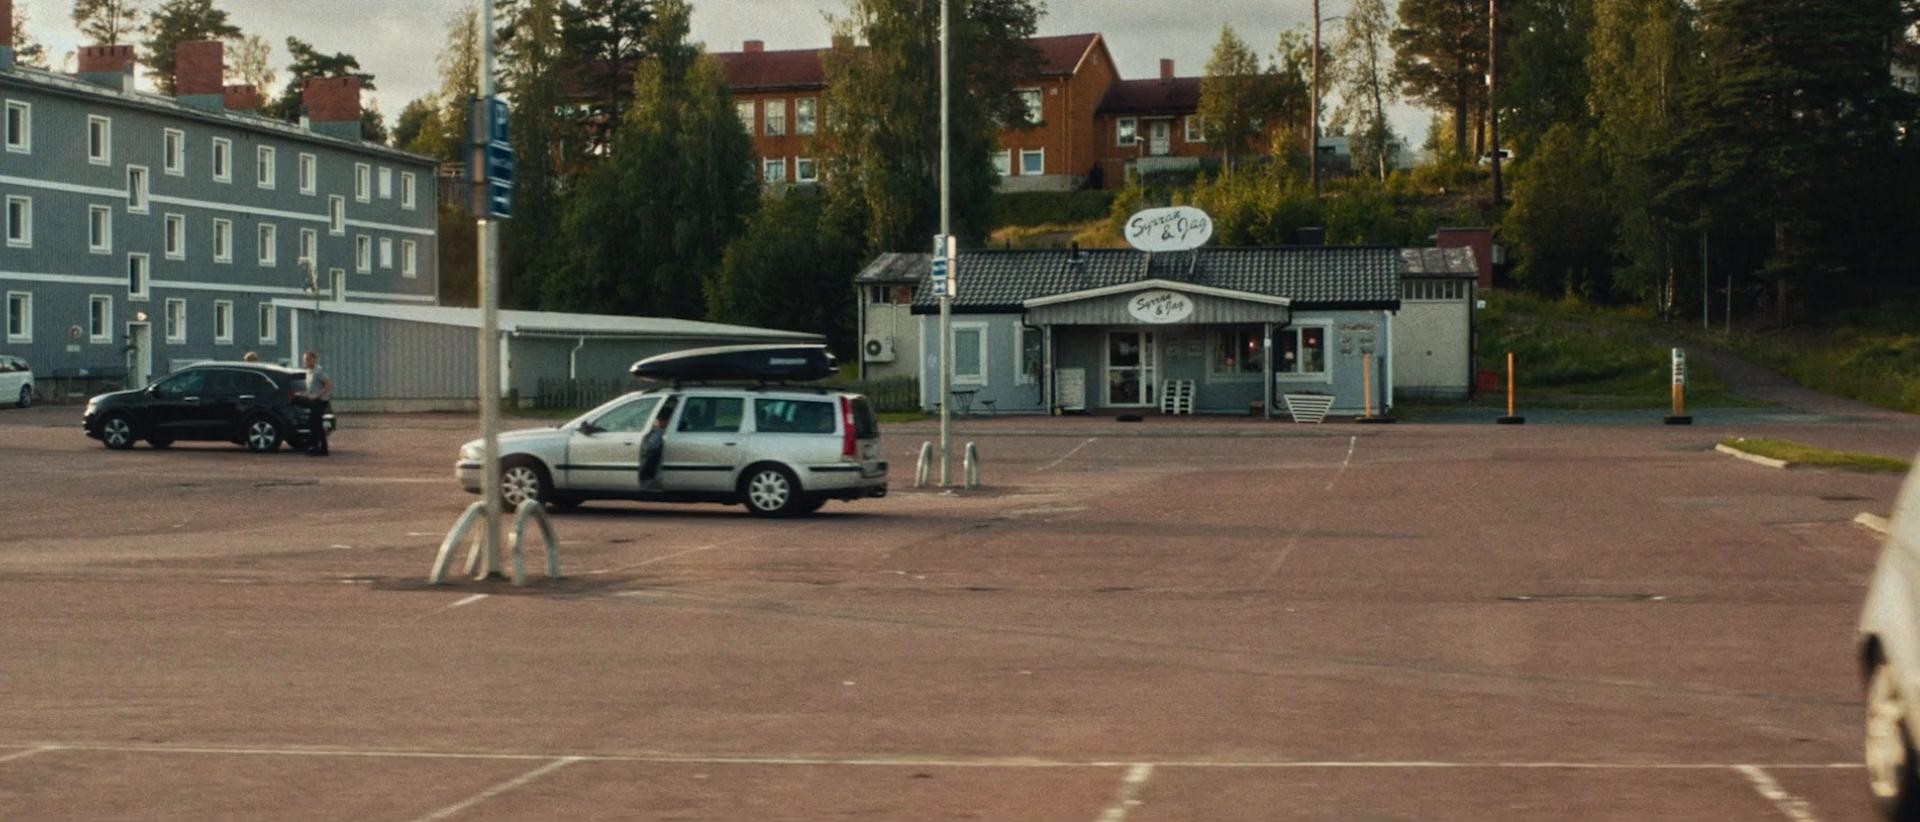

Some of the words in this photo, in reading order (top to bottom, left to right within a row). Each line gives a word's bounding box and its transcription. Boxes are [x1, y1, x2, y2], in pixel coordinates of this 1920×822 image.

[1131, 210, 1181, 237] Syrran
[1161, 224, 1175, 240] &
[1177, 217, 1207, 241] Jag
[1136, 293, 1172, 311] Syrran
[1165, 300, 1184, 316] Jag
